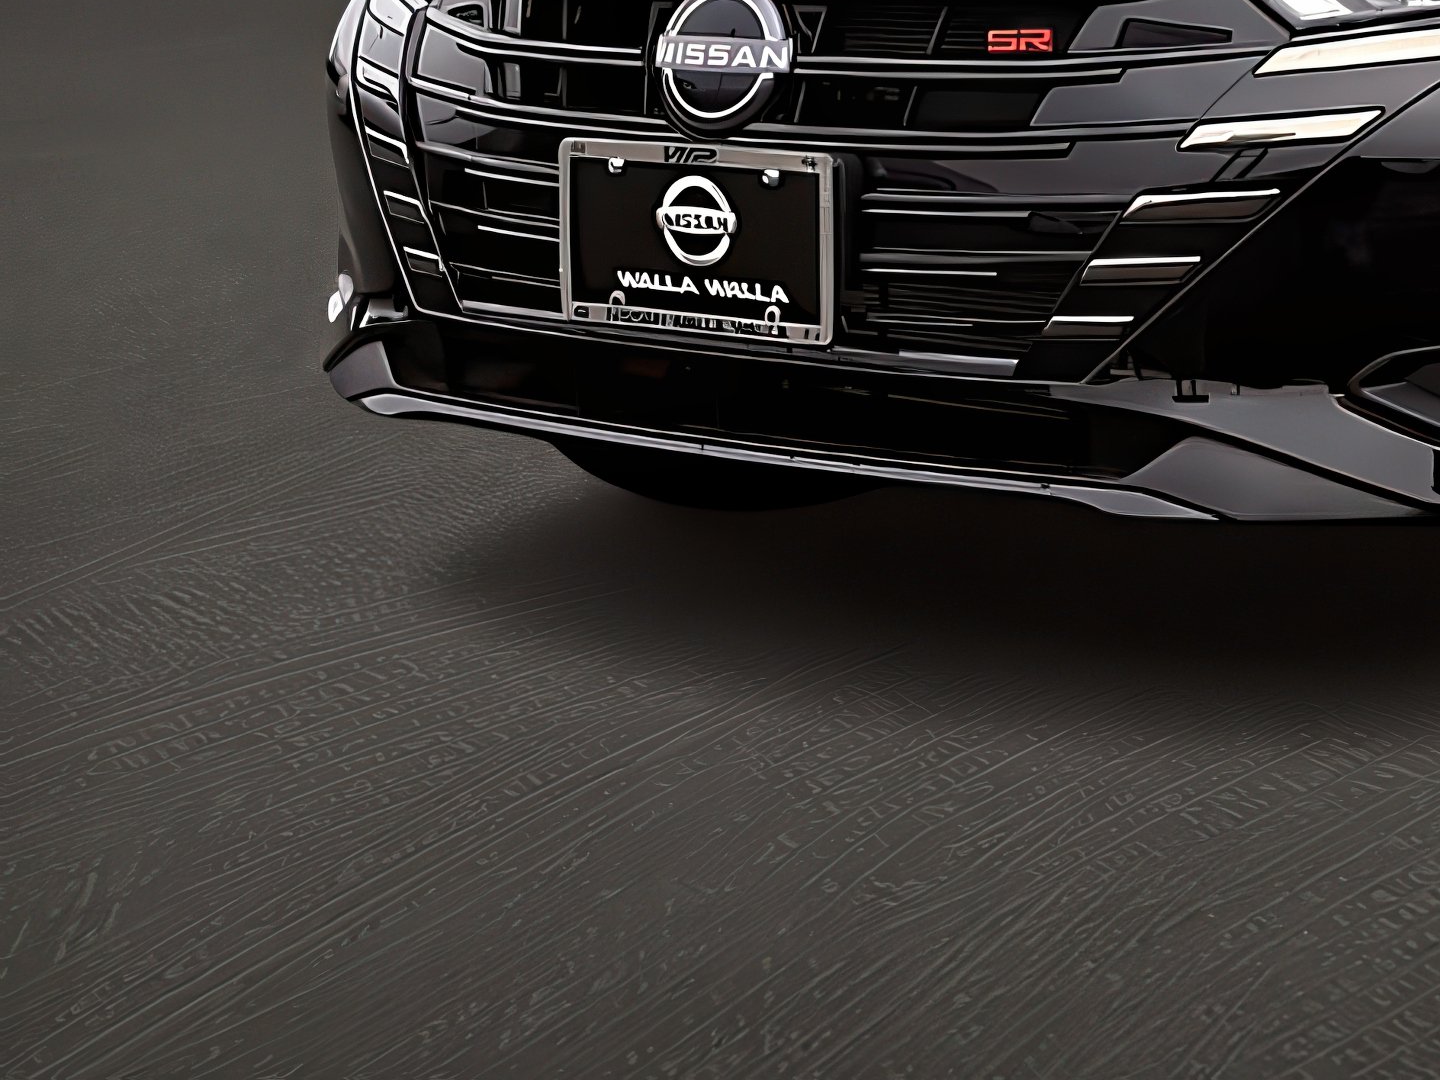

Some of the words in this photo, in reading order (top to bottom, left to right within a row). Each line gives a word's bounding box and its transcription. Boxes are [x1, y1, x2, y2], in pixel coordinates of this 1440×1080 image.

[987, 28, 1053, 52] SR
[657, 39, 788, 69] NISSAN
[616, 270, 700, 295] WALLA
